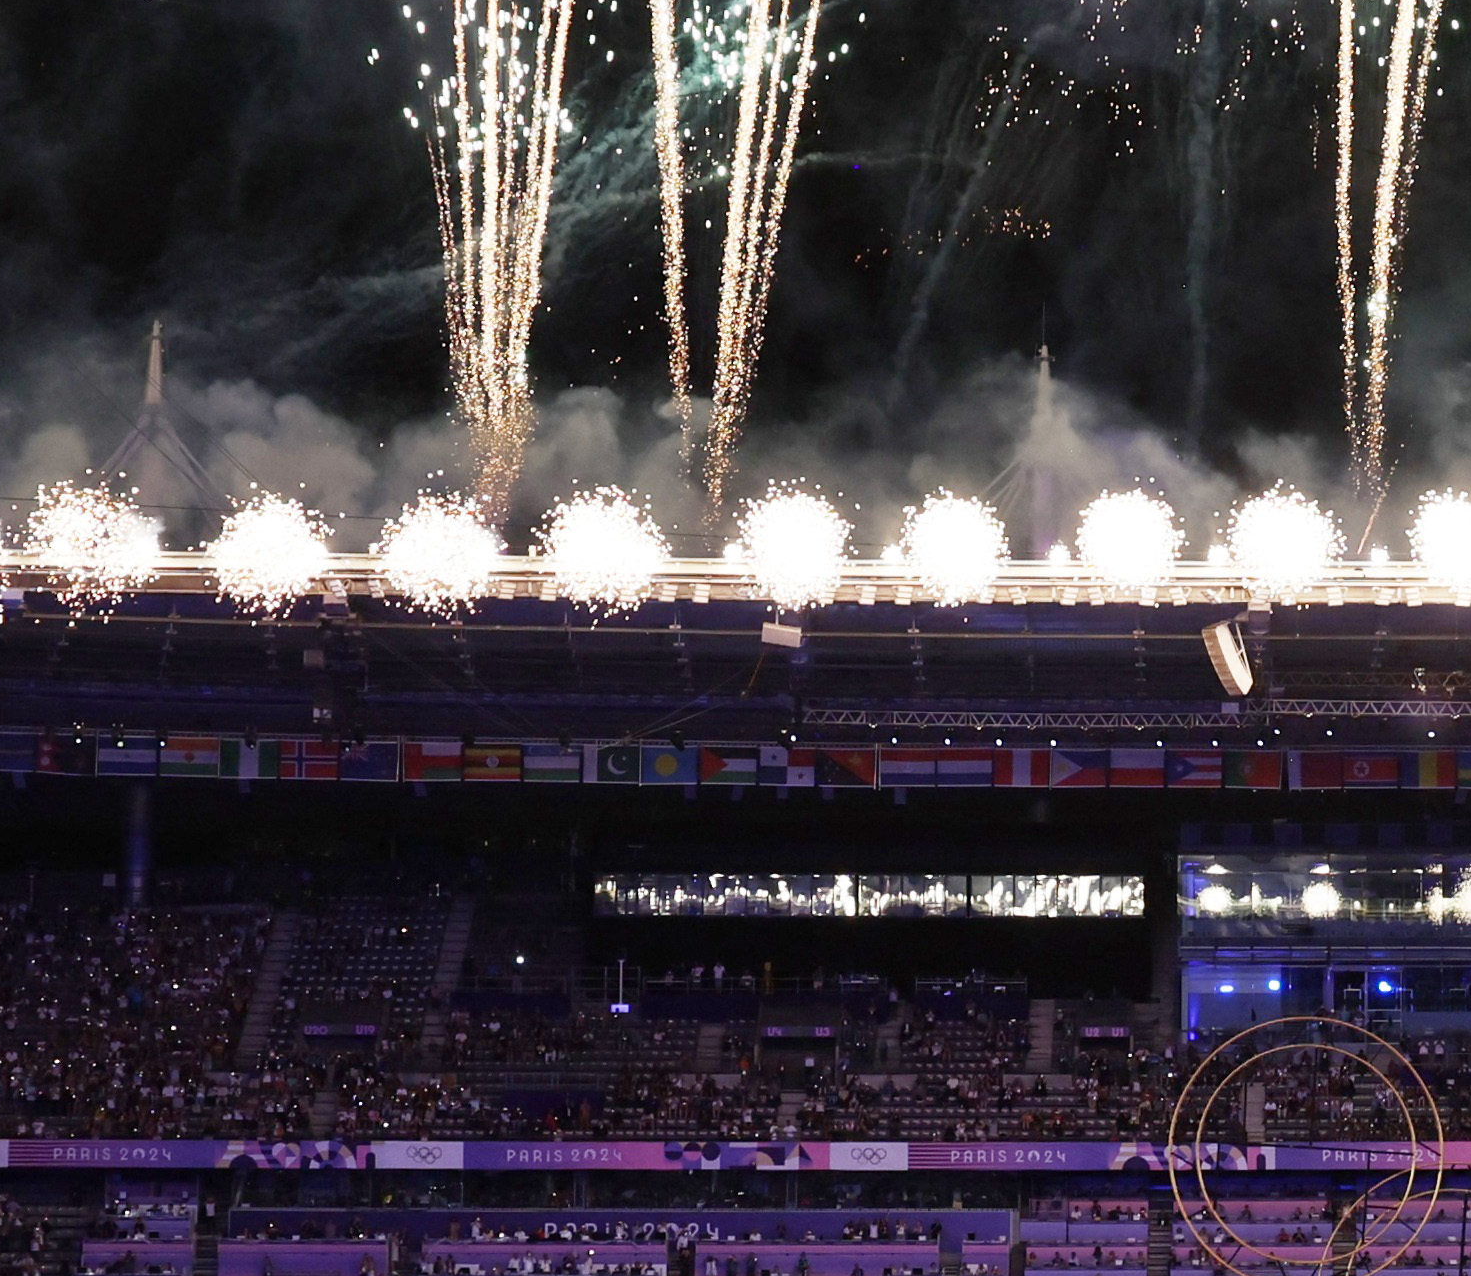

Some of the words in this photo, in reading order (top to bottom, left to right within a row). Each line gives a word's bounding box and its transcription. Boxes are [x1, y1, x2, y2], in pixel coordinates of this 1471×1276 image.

[304, 1025, 328, 1035] U20
[356, 1025, 376, 1035] U19
[768, 1027, 782, 1036] U4
[816, 1027, 830, 1036] U3
[1085, 1027, 1100, 1037] U2
[1112, 1027, 1124, 1037] U1
[53, 1147, 111, 1161] PARIS
[120, 1147, 171, 1161] 2024
[507, 1149, 562, 1162] PARIS
[570, 1149, 623, 1162] 2024
[951, 1150, 1007, 1163] PARIS
[1015, 1150, 1066, 1163] 2024
